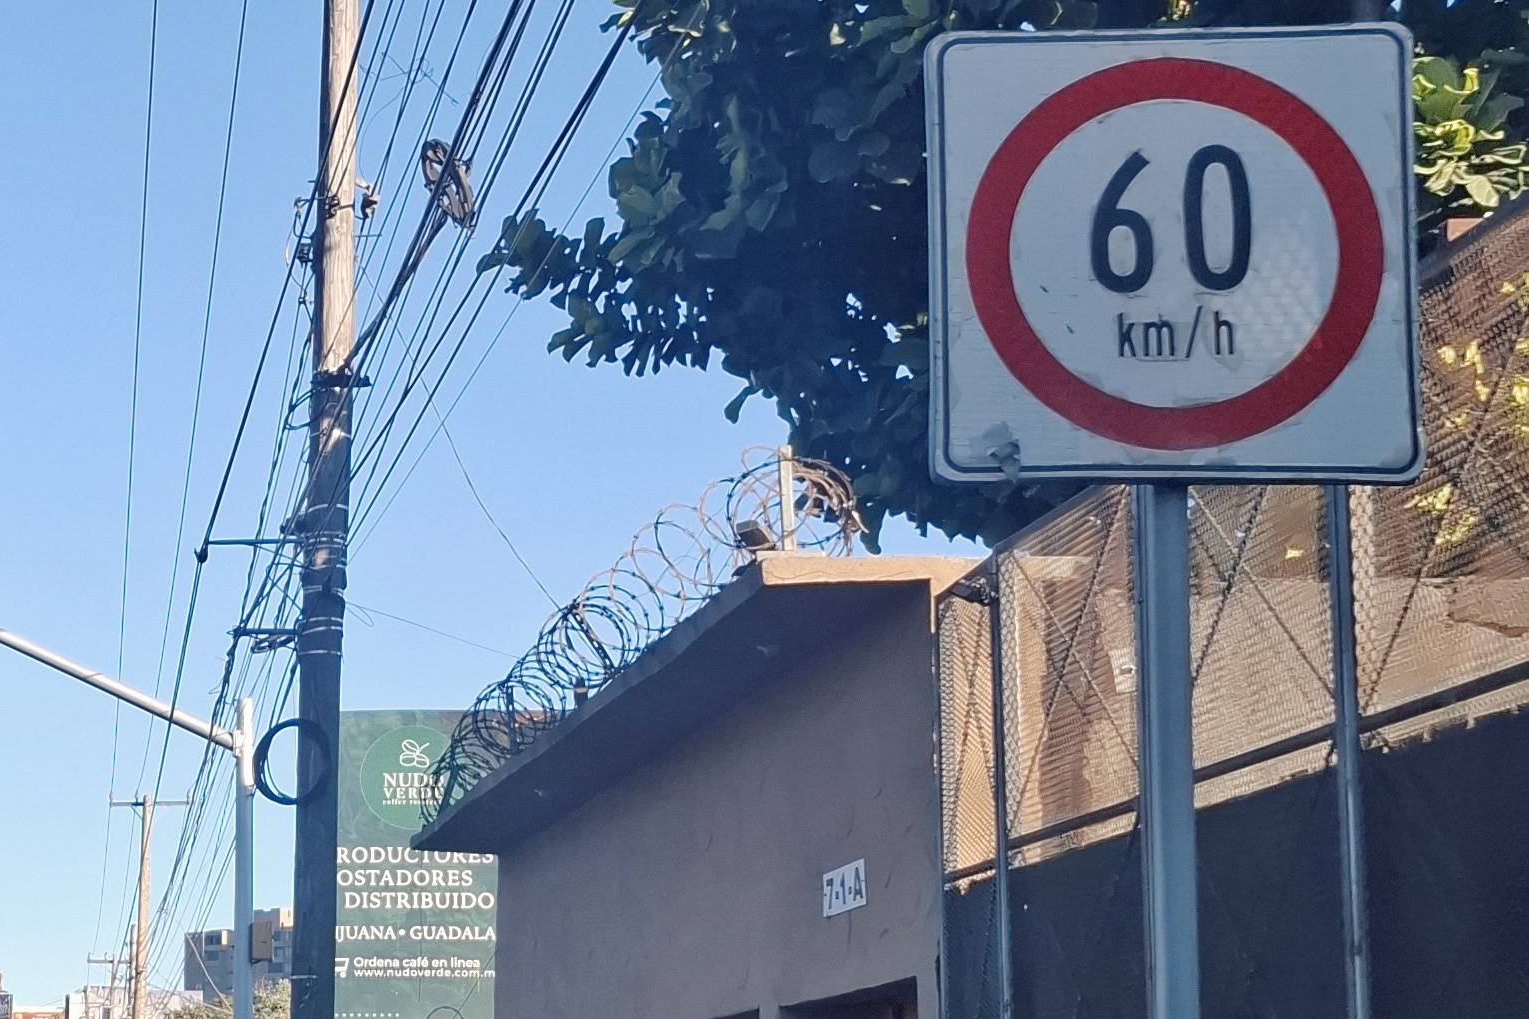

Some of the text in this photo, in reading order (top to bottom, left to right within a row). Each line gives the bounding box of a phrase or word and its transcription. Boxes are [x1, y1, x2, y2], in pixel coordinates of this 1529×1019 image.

[1090, 144, 1251, 293] 60
[1116, 306, 1236, 358] km/h
[336, 869, 474, 887] OSTADORES
[344, 891, 495, 910] DISTRIBUIDO
[409, 925, 497, 940] GUADALA
[353, 956, 400, 968] Ordena
[402, 956, 429, 968] café
[431, 959, 448, 968] en
